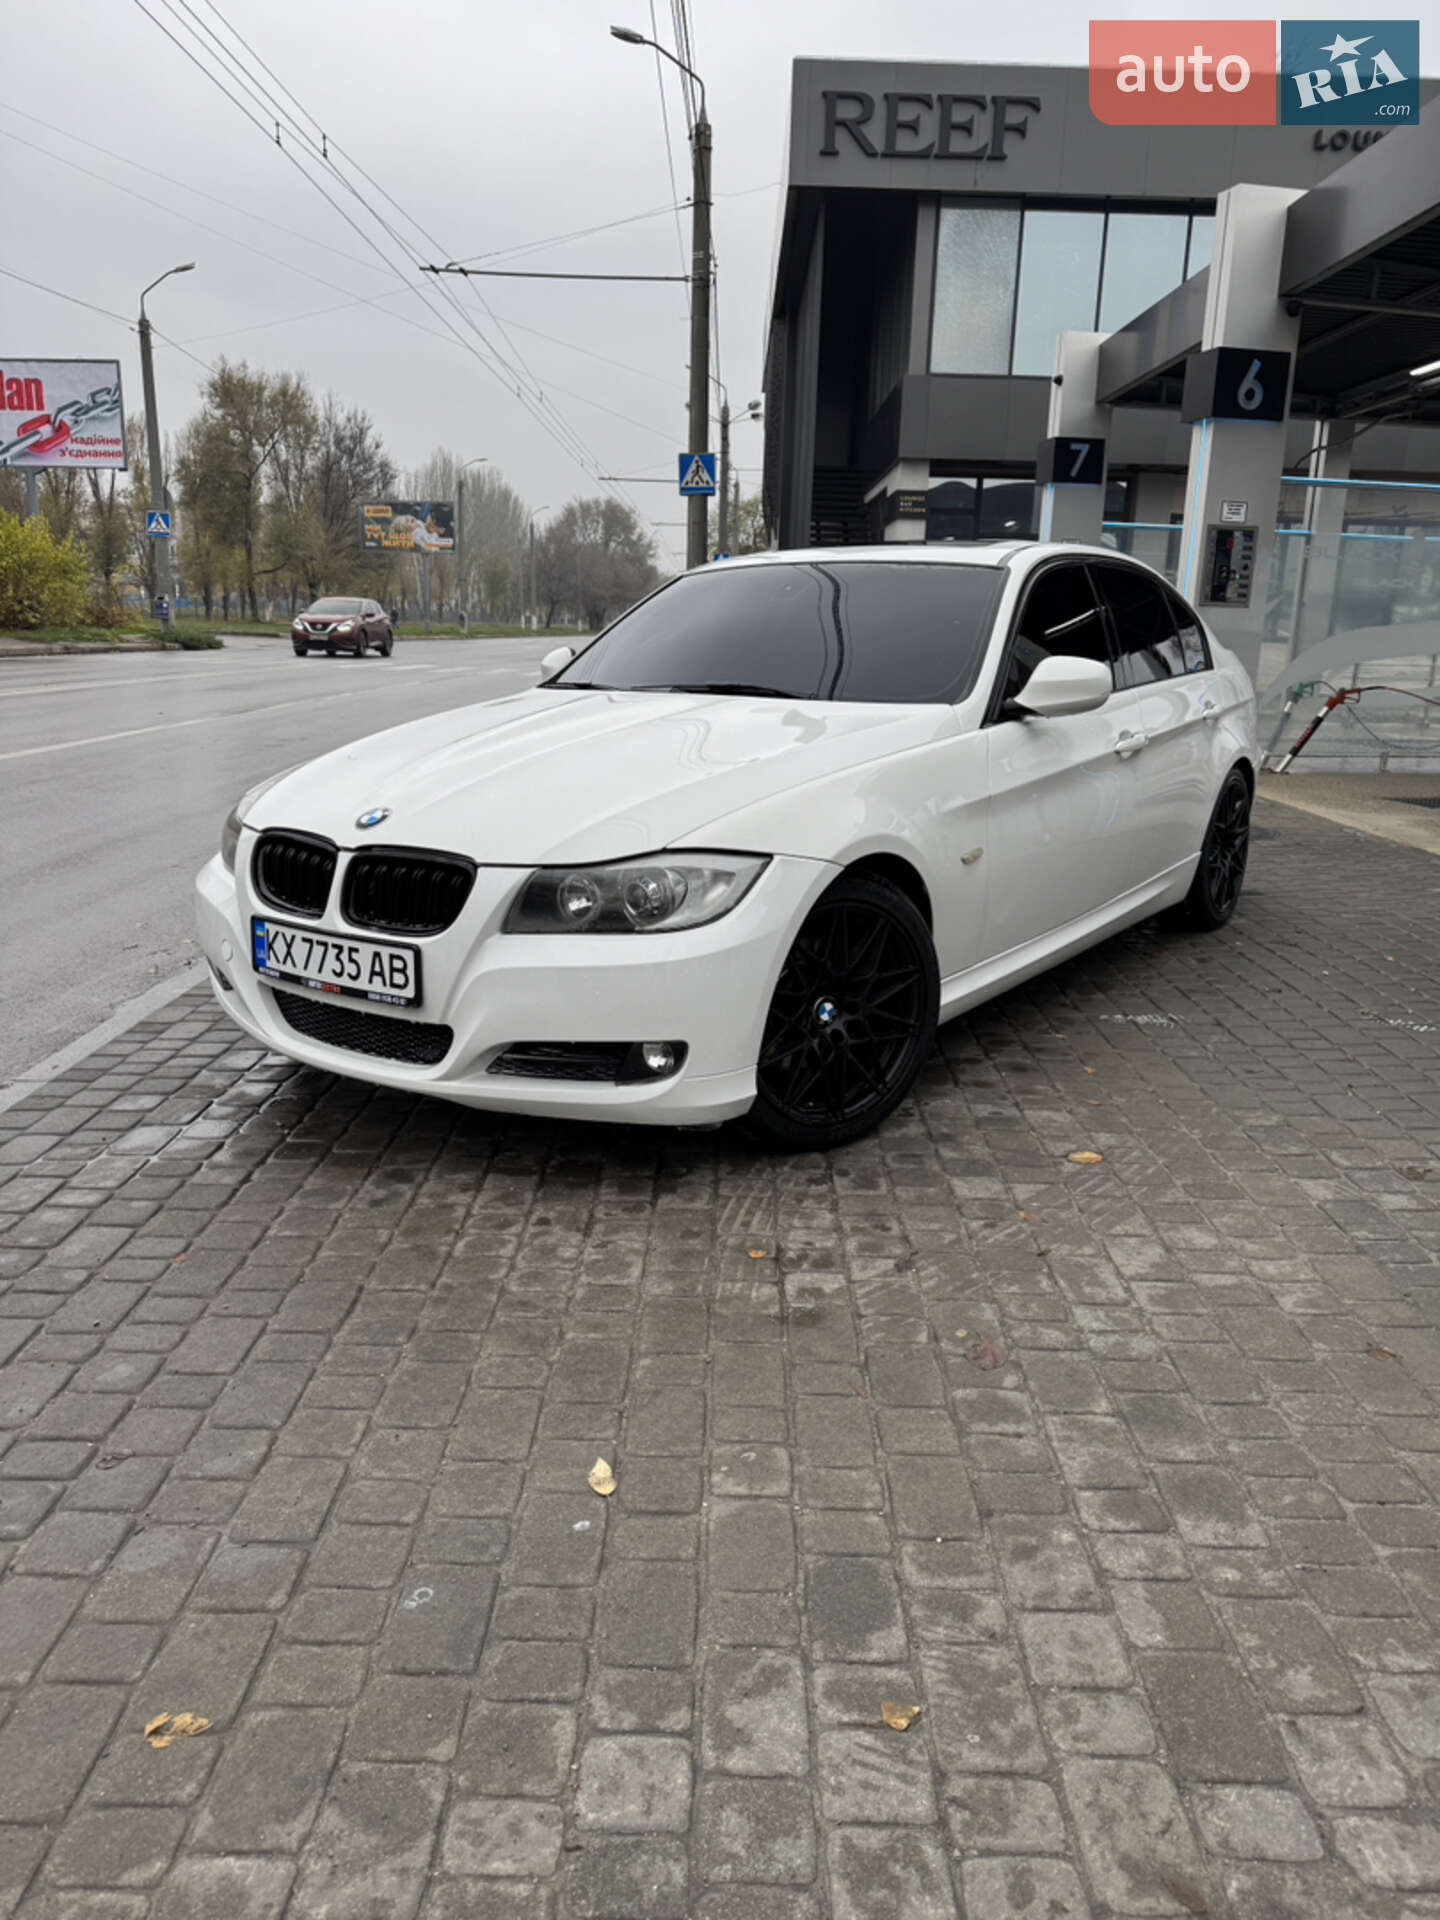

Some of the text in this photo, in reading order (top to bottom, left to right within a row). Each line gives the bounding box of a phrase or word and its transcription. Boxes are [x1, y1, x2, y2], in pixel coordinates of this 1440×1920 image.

[819, 90, 1041, 161] REEF
[1238, 359, 1263, 410] 6
[1070, 443, 1091, 477] 7
[368, 951, 409, 990] AB
